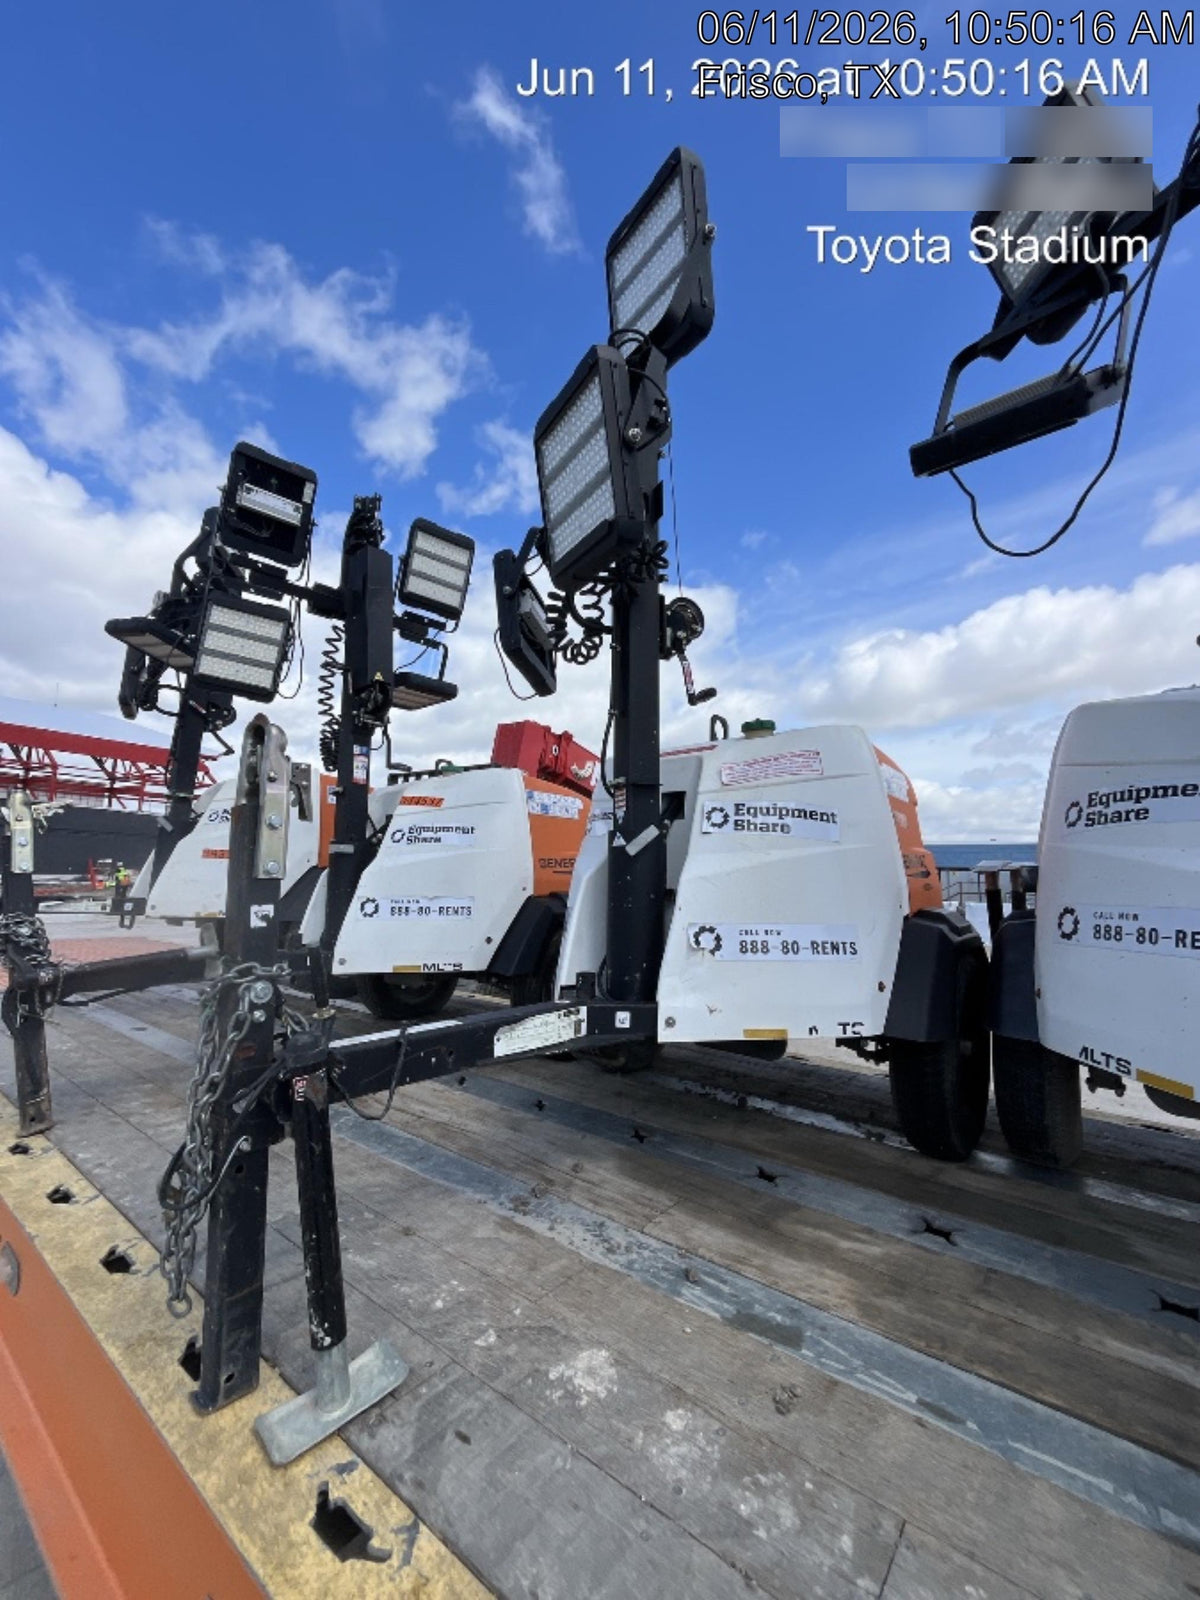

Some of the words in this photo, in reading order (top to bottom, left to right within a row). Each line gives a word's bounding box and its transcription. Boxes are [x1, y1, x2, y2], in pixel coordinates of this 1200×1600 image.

[1087, 783, 1200, 809] Equipme
[734, 803, 838, 824] Equipment
[1084, 806, 1150, 828] Share
[733, 819, 792, 835] Share
[738, 939, 859, 956] 888-80-RENTS
